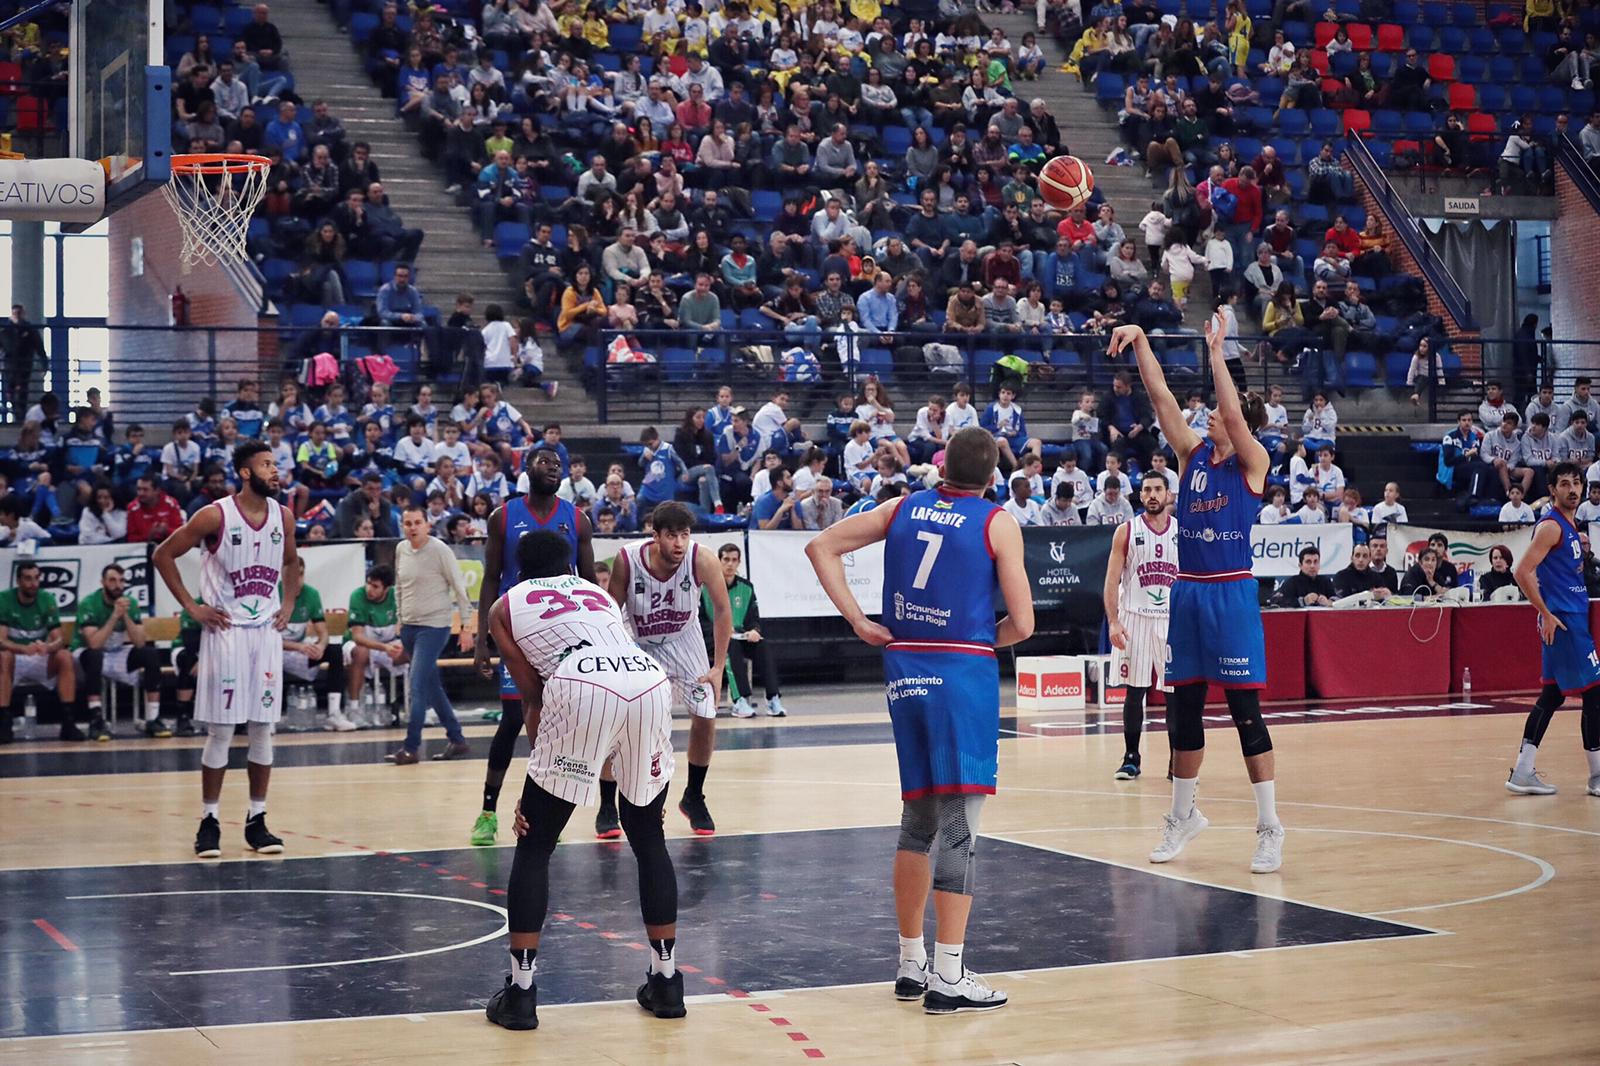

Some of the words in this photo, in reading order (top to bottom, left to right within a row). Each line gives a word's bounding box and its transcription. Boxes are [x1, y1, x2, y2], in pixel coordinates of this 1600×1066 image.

[1448, 202, 1476, 210] SALIDA
[1190, 468, 1208, 493] 10
[911, 506, 968, 528] LAFUENTE
[1214, 531, 1244, 540] VEGA
[253, 542, 261, 560] 7
[1155, 543, 1164, 558] 9
[1570, 540, 1581, 559] 19
[912, 530, 944, 590] 7
[1047, 568, 1072, 576] HOTEL
[1137, 561, 1178, 577] PLASENCI
[1039, 577, 1065, 585] GRAN
[1139, 574, 1175, 588] AMBRO
[526, 590, 612, 619] 32
[651, 589, 675, 609] 24
[633, 608, 692, 625] PLASENCIA
[926, 615, 947, 627] Rioja
[638, 622, 686, 637] AMBROZ
[577, 656, 660, 674] CEVESA
[1120, 663, 1129, 678] 9
[1044, 684, 1079, 695] Adecco
[223, 689, 234, 709] 7
